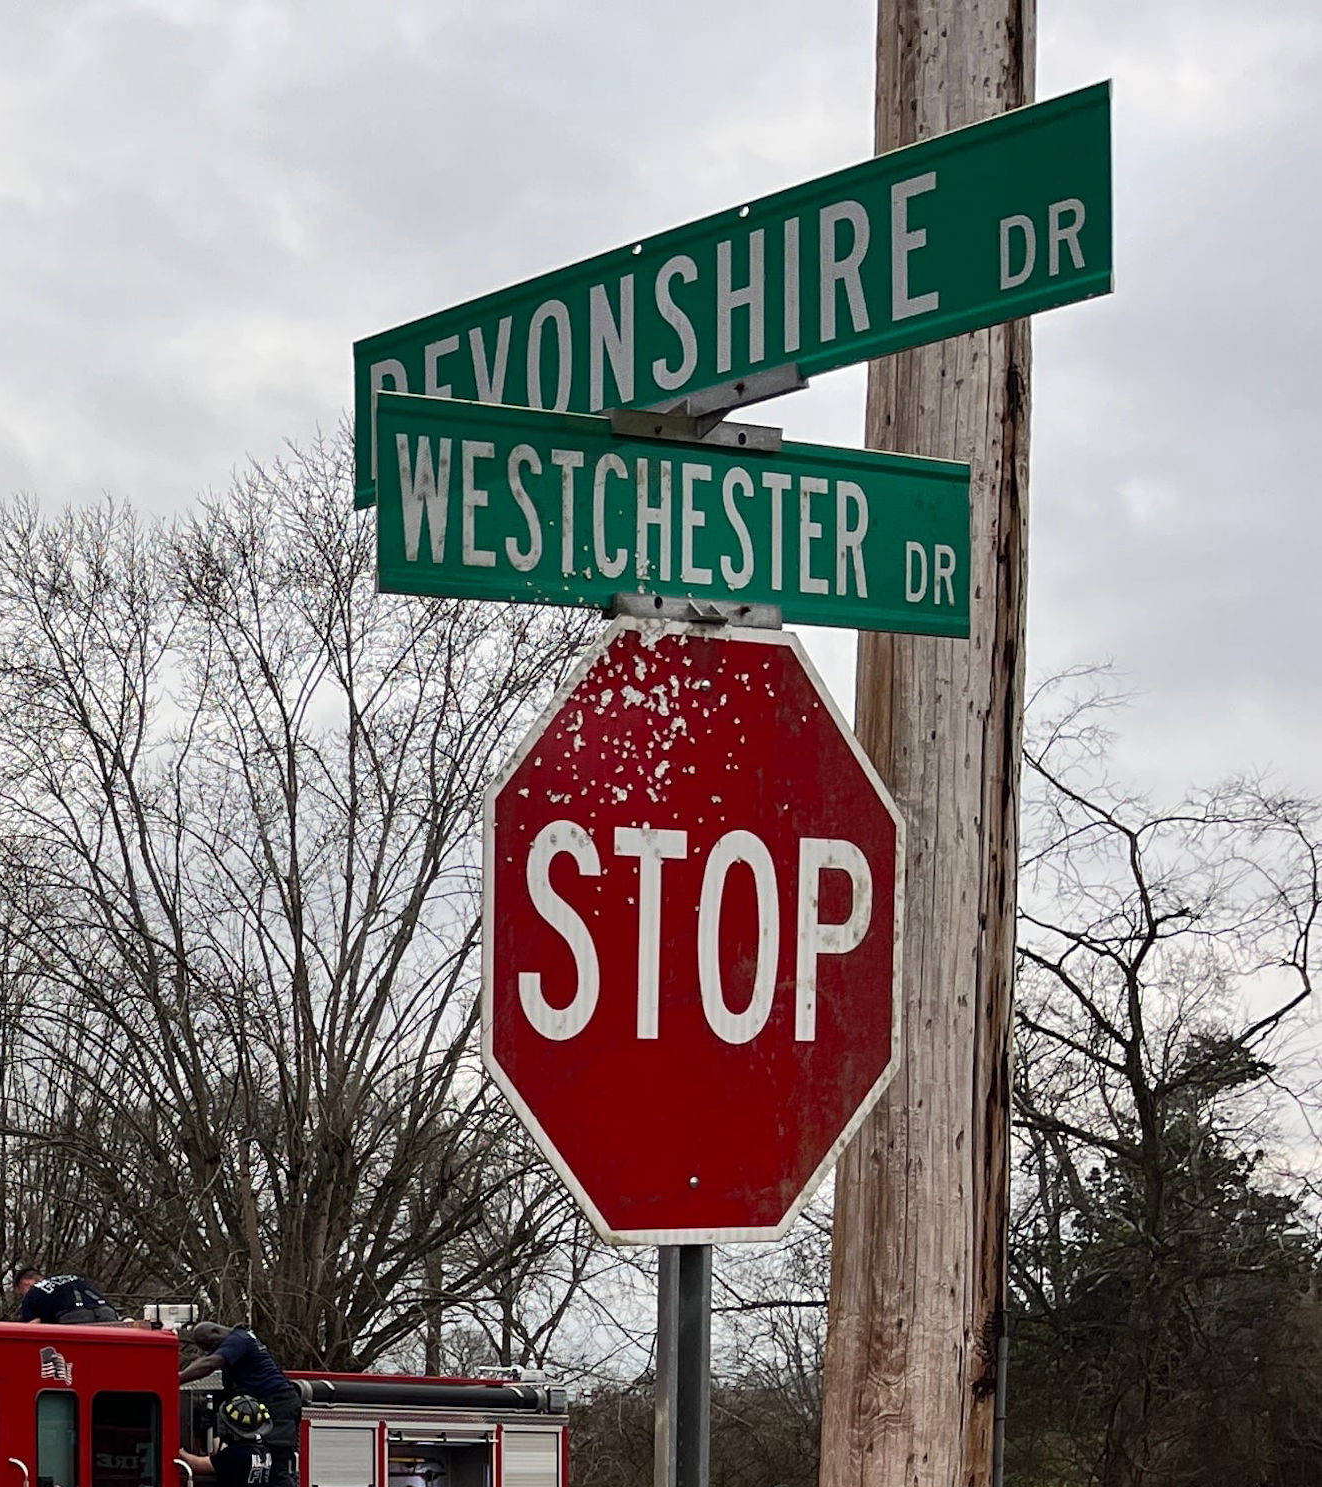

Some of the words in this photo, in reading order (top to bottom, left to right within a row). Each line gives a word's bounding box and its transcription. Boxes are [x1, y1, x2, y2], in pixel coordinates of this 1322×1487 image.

[999, 198, 1086, 290] DR
[397, 433, 868, 599] WESTCHESTER
[905, 540, 957, 607] DR
[518, 819, 873, 1046] STOP
